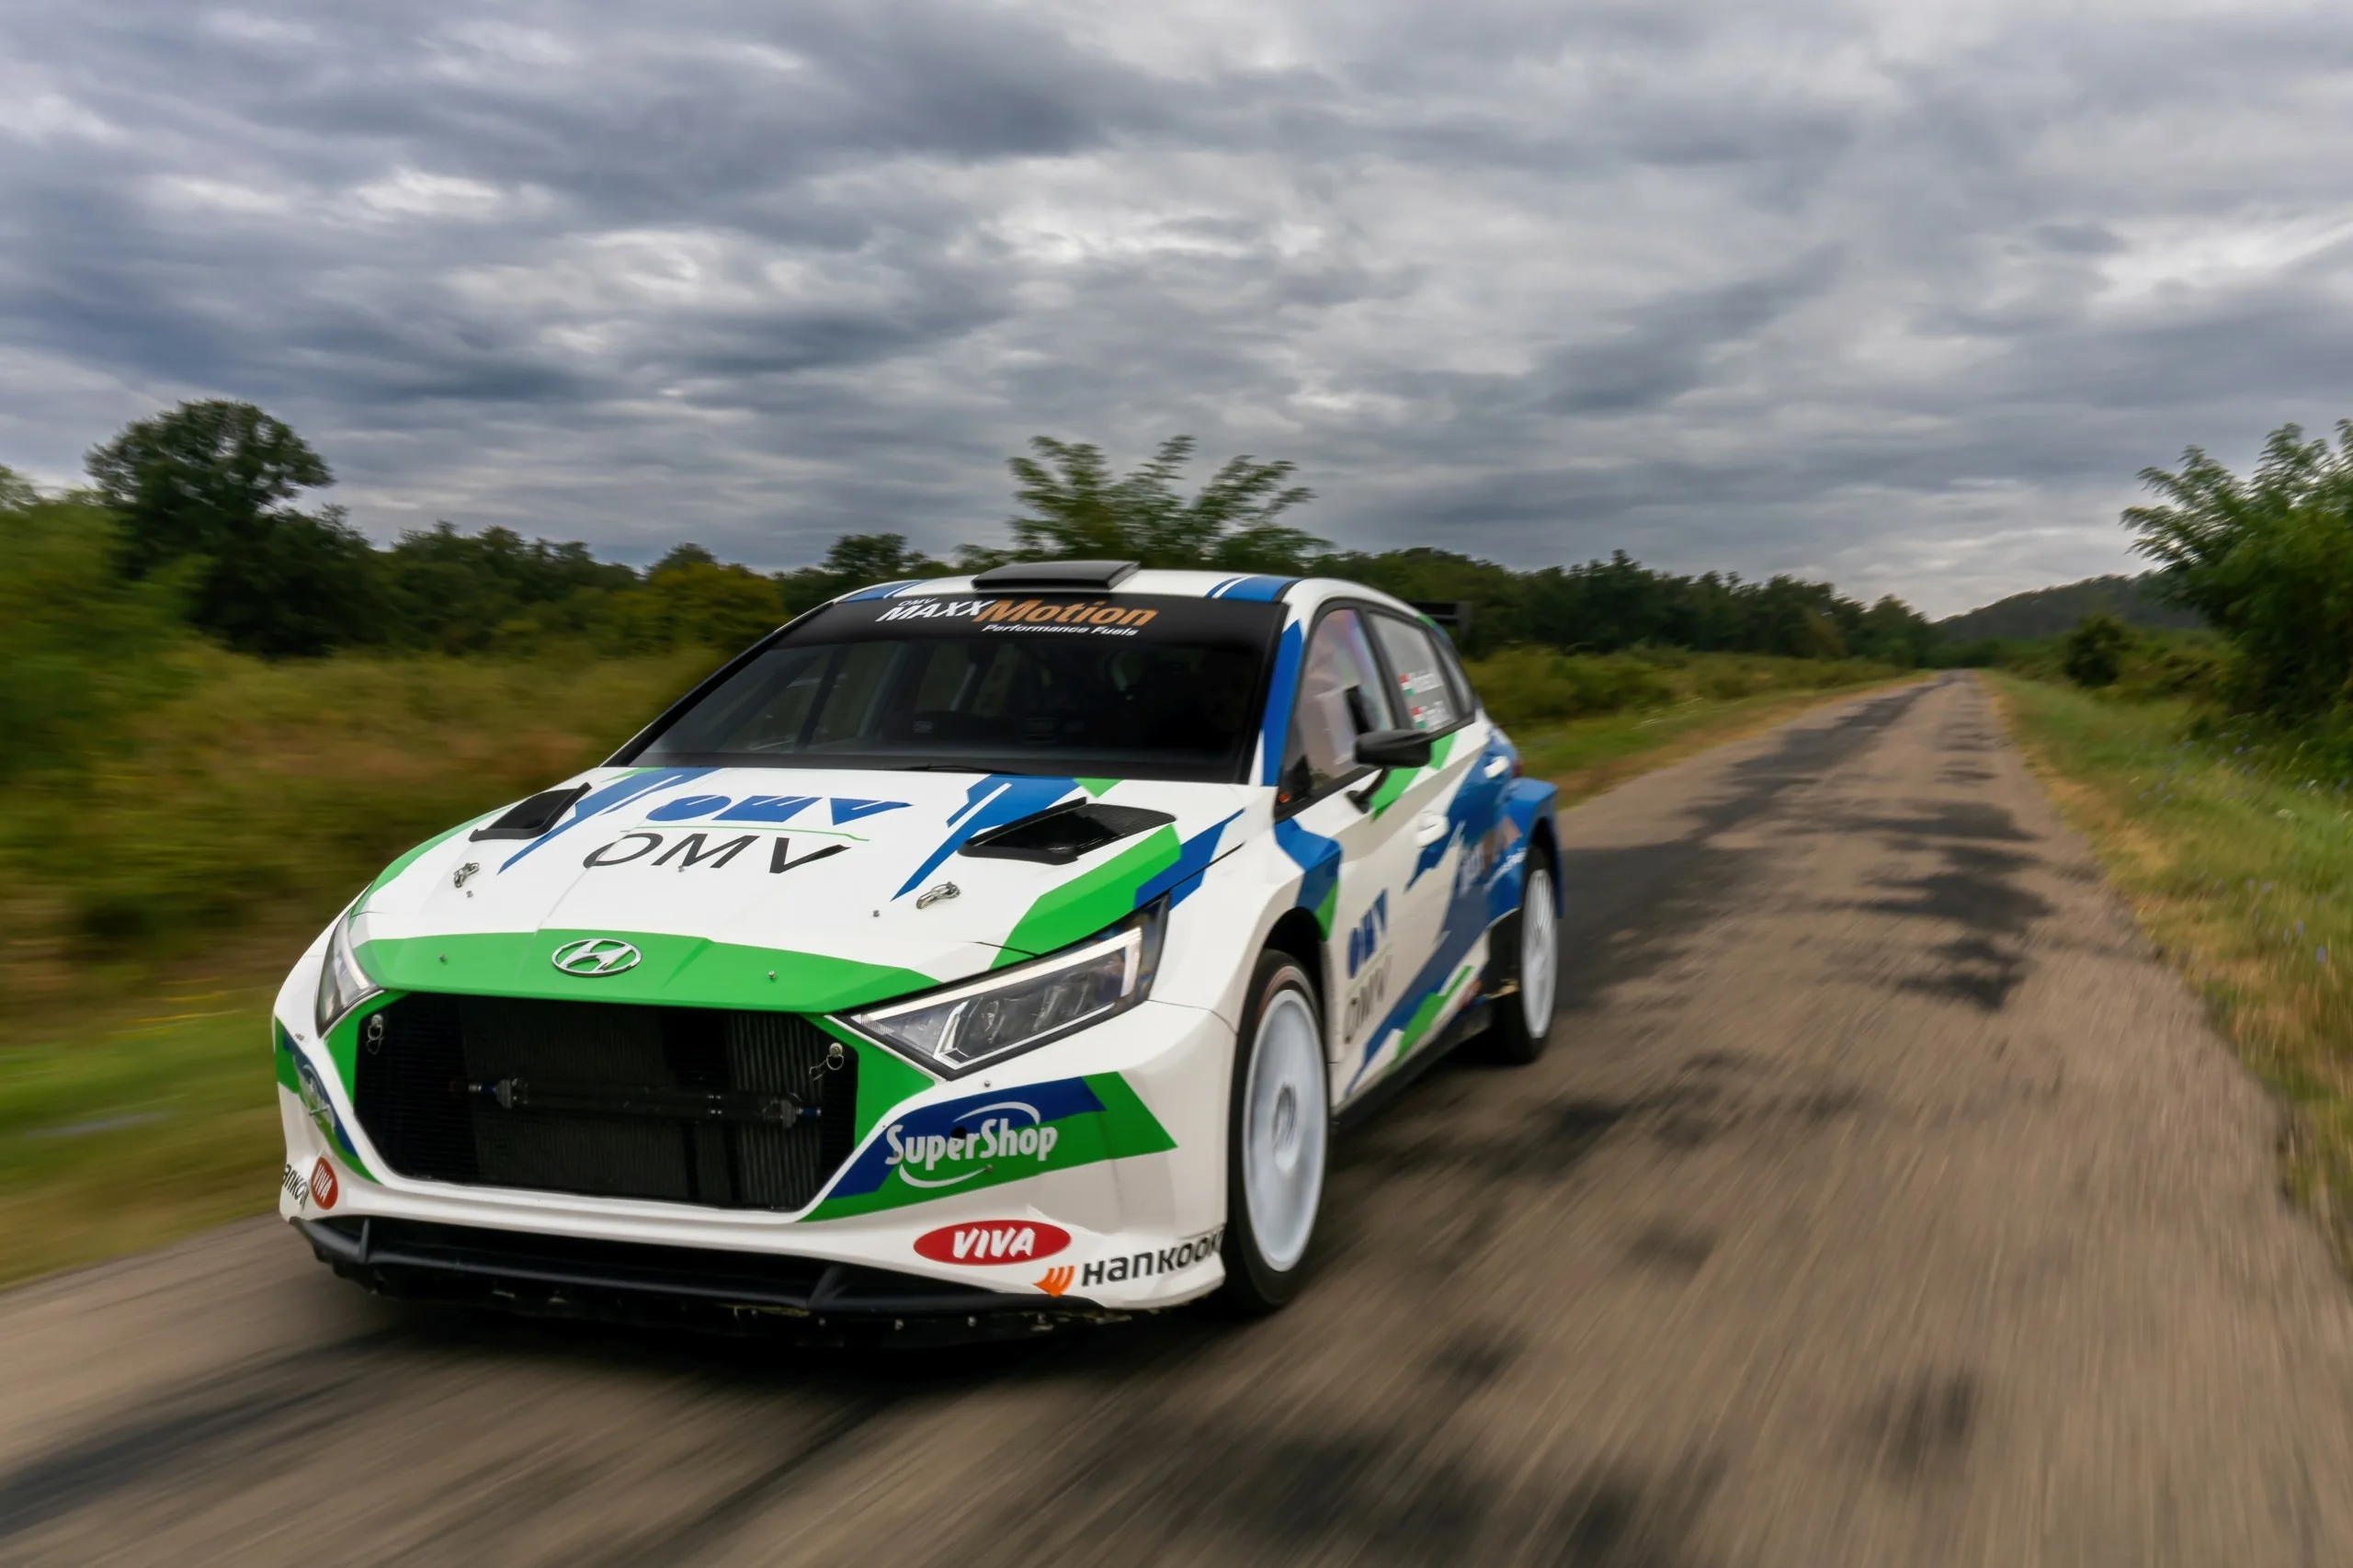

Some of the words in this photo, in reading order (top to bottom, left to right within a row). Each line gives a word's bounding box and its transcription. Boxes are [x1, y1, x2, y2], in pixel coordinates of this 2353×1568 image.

[898, 597, 938, 607] OMV
[982, 624, 1089, 633] Performance
[1090, 626, 1139, 636] Fuels
[647, 795, 914, 825] OMV
[583, 833, 851, 874] OMV
[885, 1118, 1057, 1170] SuperShop
[951, 1227, 1036, 1259] VIVA
